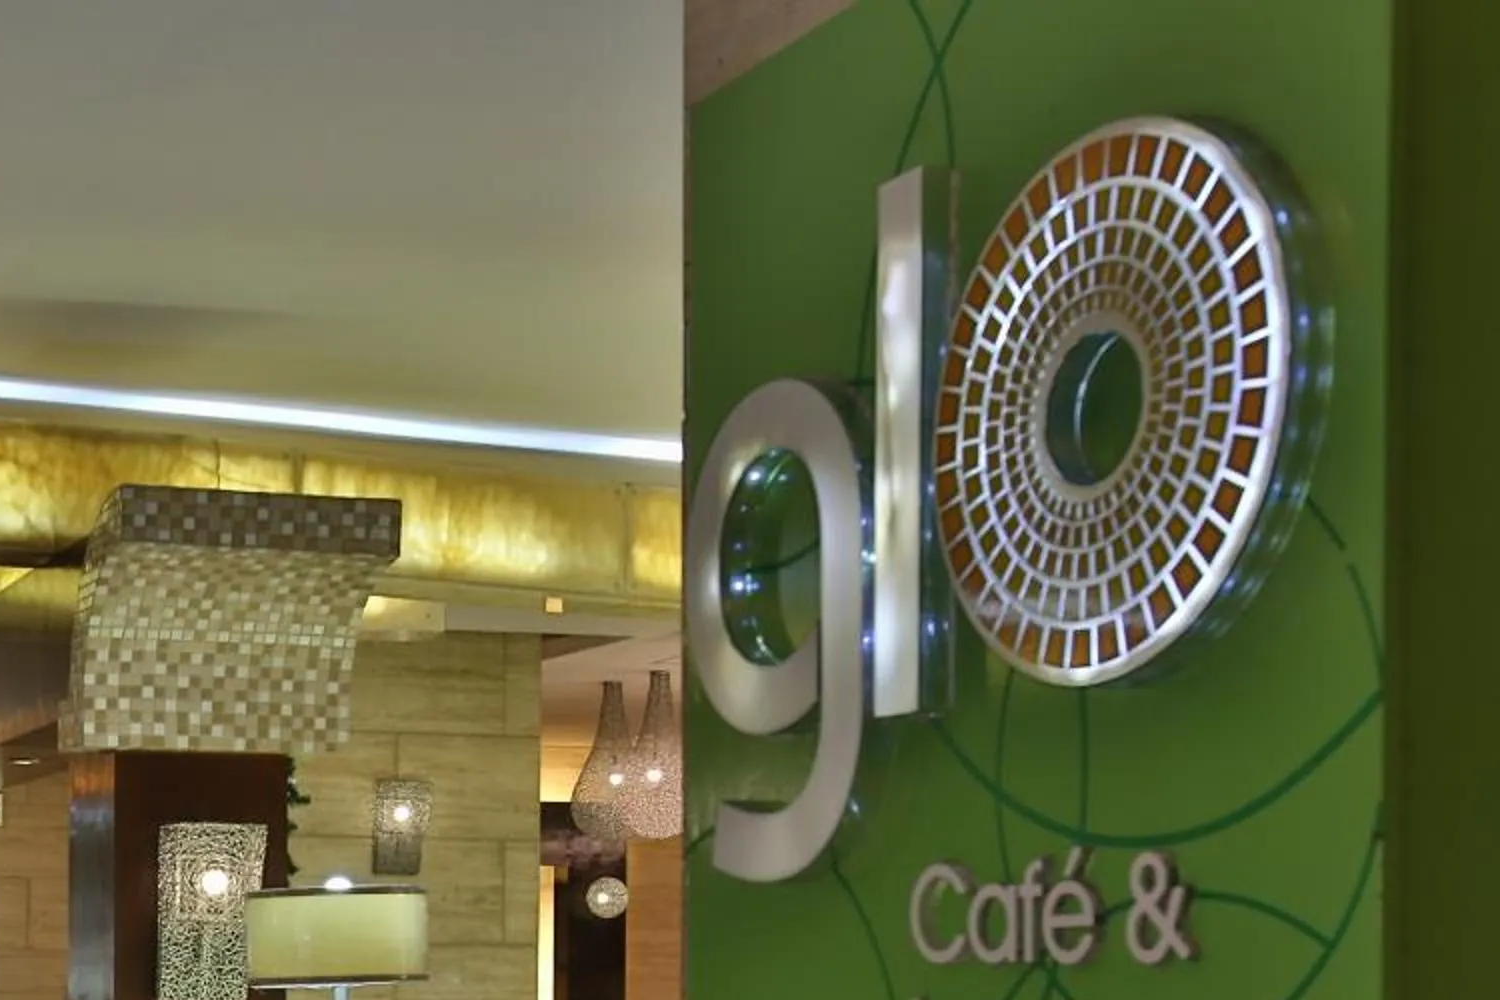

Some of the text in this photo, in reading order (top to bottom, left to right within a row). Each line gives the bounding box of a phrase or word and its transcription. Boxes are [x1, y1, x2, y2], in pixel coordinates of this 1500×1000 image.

[687, 114, 1297, 884] glo
[910, 846, 1198, 967] Café &
